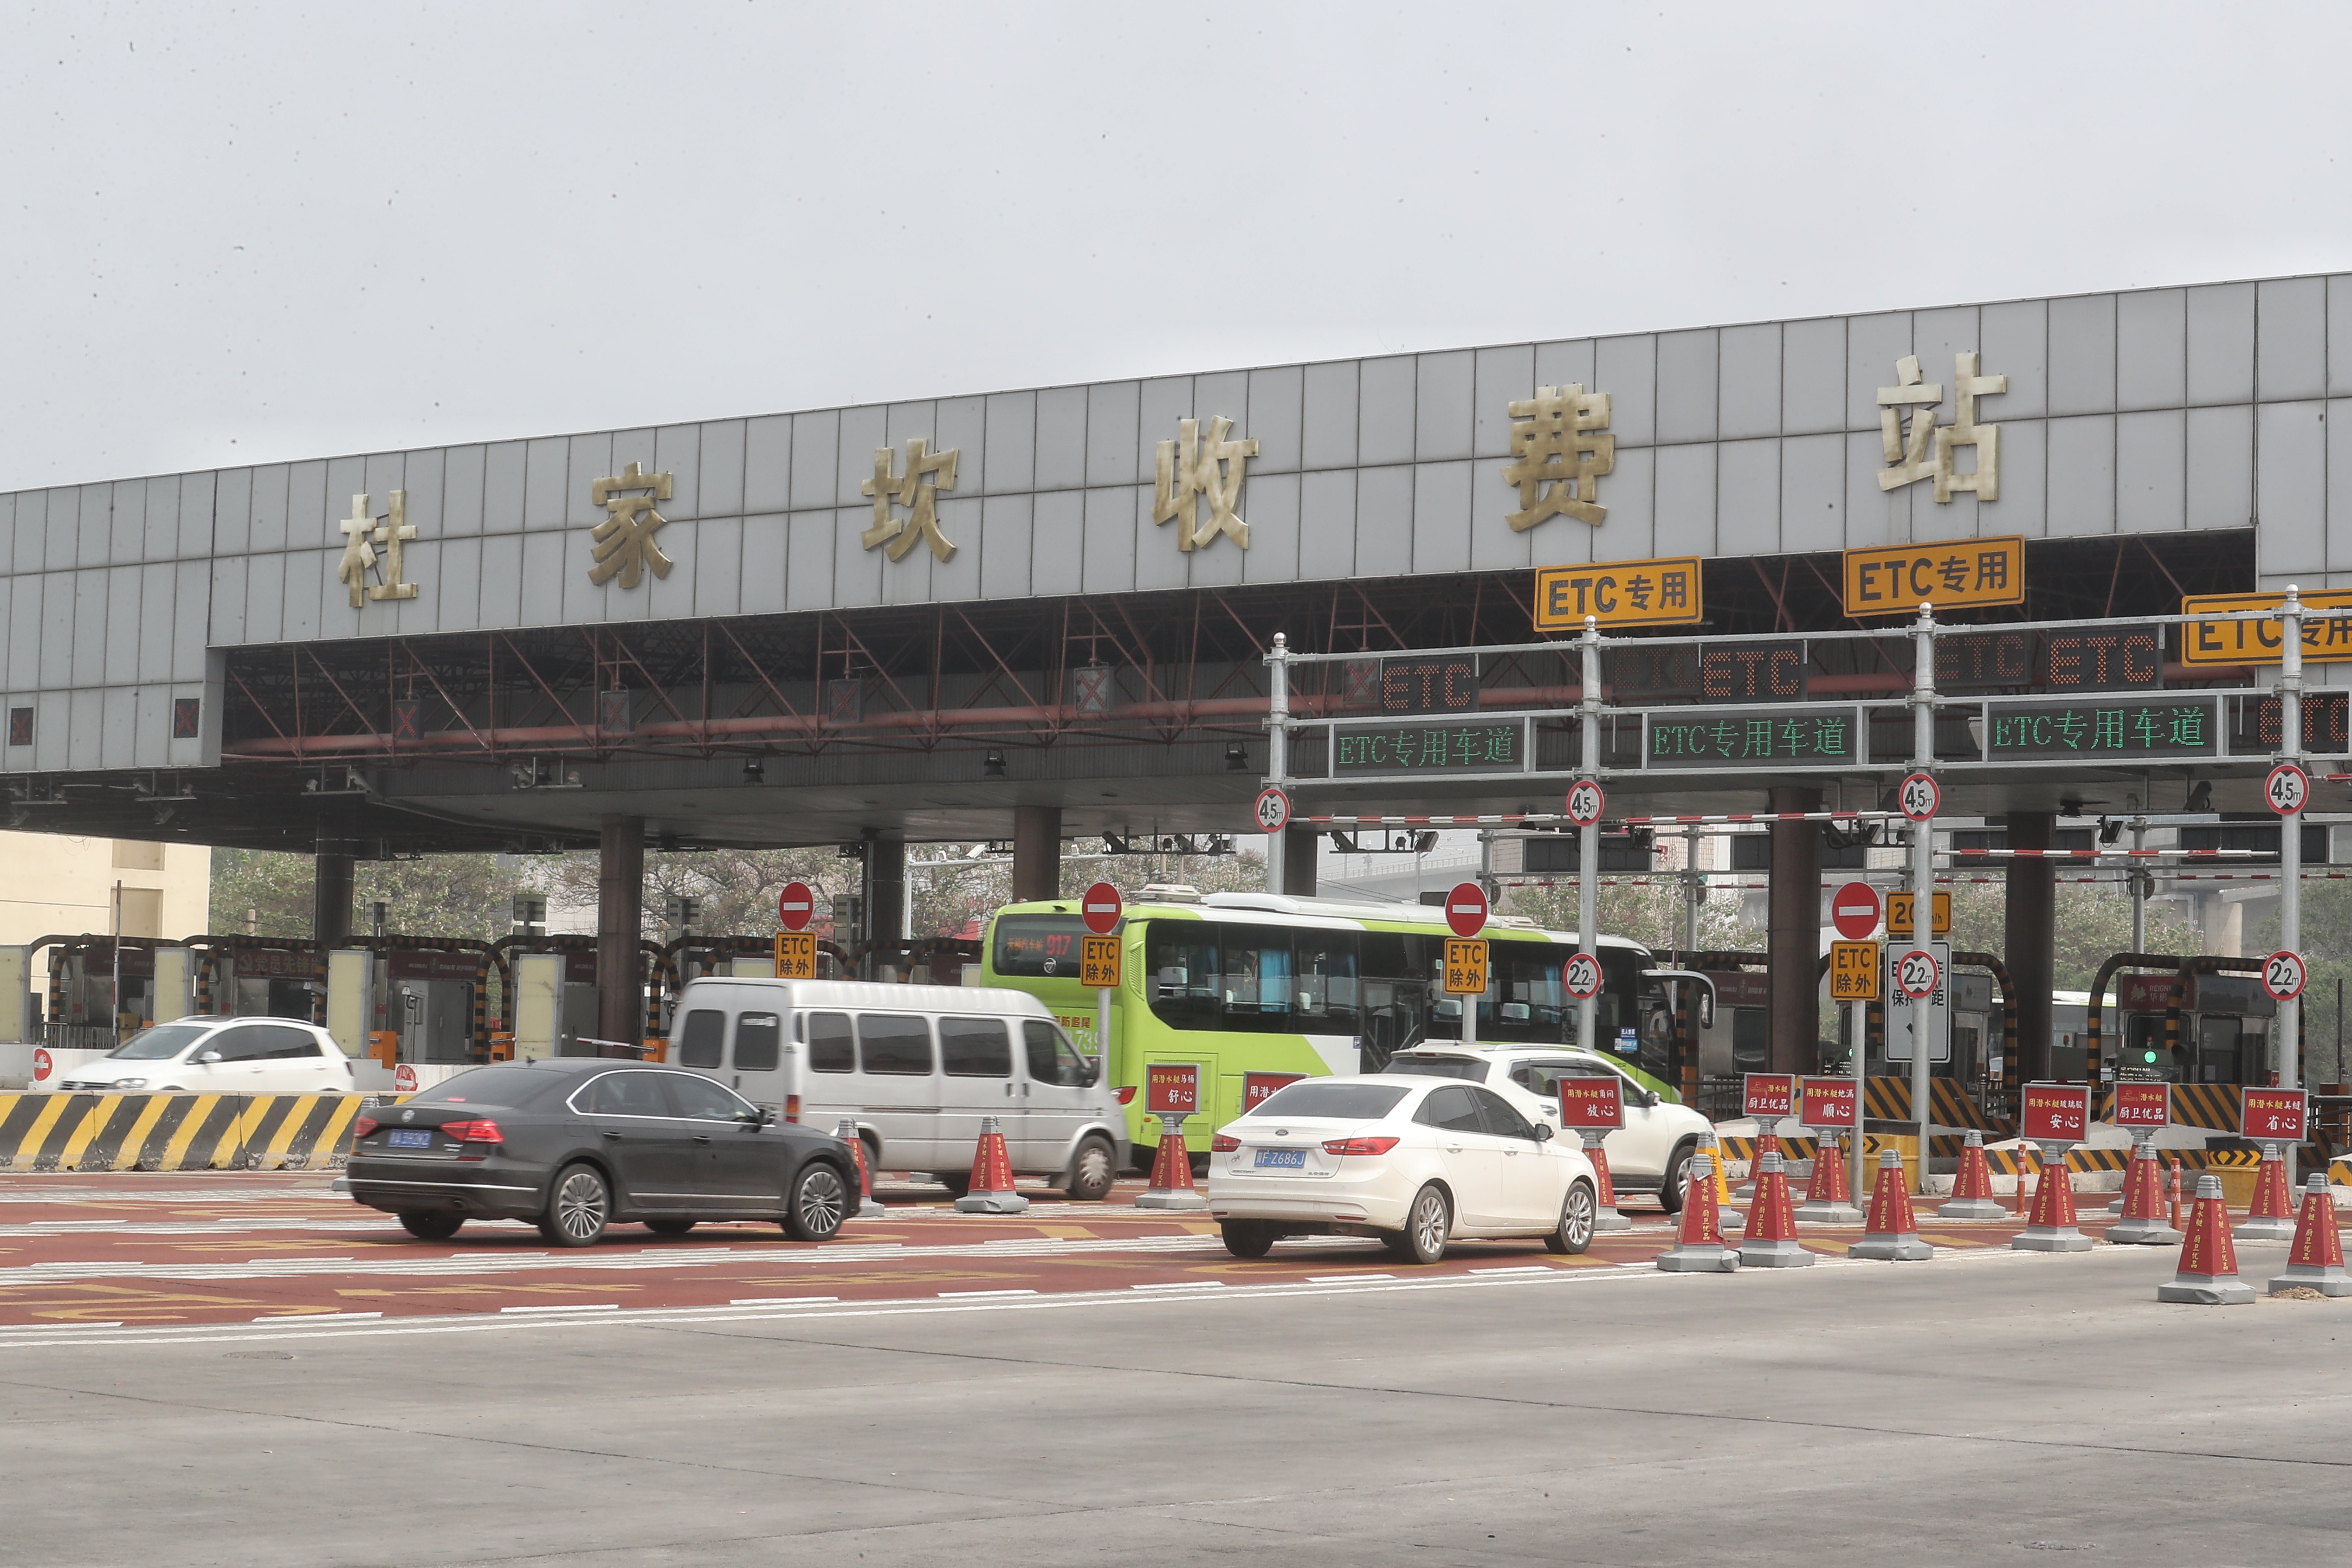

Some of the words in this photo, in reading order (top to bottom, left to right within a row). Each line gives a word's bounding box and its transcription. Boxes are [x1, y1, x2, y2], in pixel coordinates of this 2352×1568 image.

[1859, 551, 2007, 601] ETC专用
[2050, 636, 2154, 685] ETC
[1703, 651, 1799, 696] ETC
[1383, 664, 1471, 709] ETC
[1654, 717, 1846, 757] ETC专用车道
[1995, 707, 2205, 749] ETC专用车道
[1339, 726, 1514, 767] ETC专用车道
[1905, 786, 1932, 807] 4.5m
[2270, 778, 2300, 801] 4.5m
[1259, 794, 1283, 820] 4.5m
[1571, 793, 1598, 814] 4.5m
[782, 938, 808, 955] ETC
[1046, 935, 1072, 955] 917
[1087, 942, 1115, 959] ETC
[1450, 945, 1481, 964] ETC
[780, 959, 809, 975] 除外
[1838, 948, 1871, 968] ETC
[1086, 964, 1114, 981] 除外
[1449, 968, 1480, 987] 除外
[1570, 965, 1595, 986] 2.2m
[1904, 962, 1932, 985] 2.2m
[2269, 963, 2299, 985] 2.2m
[1836, 973, 1871, 994] 除外
[1892, 989, 1944, 1007] 保持距
[1152, 1074, 1195, 1084] 用潜水艇马桶
[1768, 1084, 1788, 1093] 潜水艇
[1168, 1089, 1193, 1103] 舒心
[1807, 1088, 1854, 1098] 用潜水艇地漏
[2140, 1093, 2163, 1102] 潜水艇
[1587, 1104, 1614, 1117] 放心
[1748, 1097, 1788, 1110] 厨卫优品
[1822, 1103, 1850, 1118] 顺心
[2248, 1098, 2301, 1110] 用潜水艇美缝
[2050, 1114, 2080, 1129] 安心
[2119, 1107, 2164, 1120] 厨卫优品
[2266, 1115, 2297, 1131] 省心
[1701, 1179, 1710, 1240] 潜水艇·厨卫优品
[2191, 1202, 2204, 1268] 潜水艇·厨卫优品
